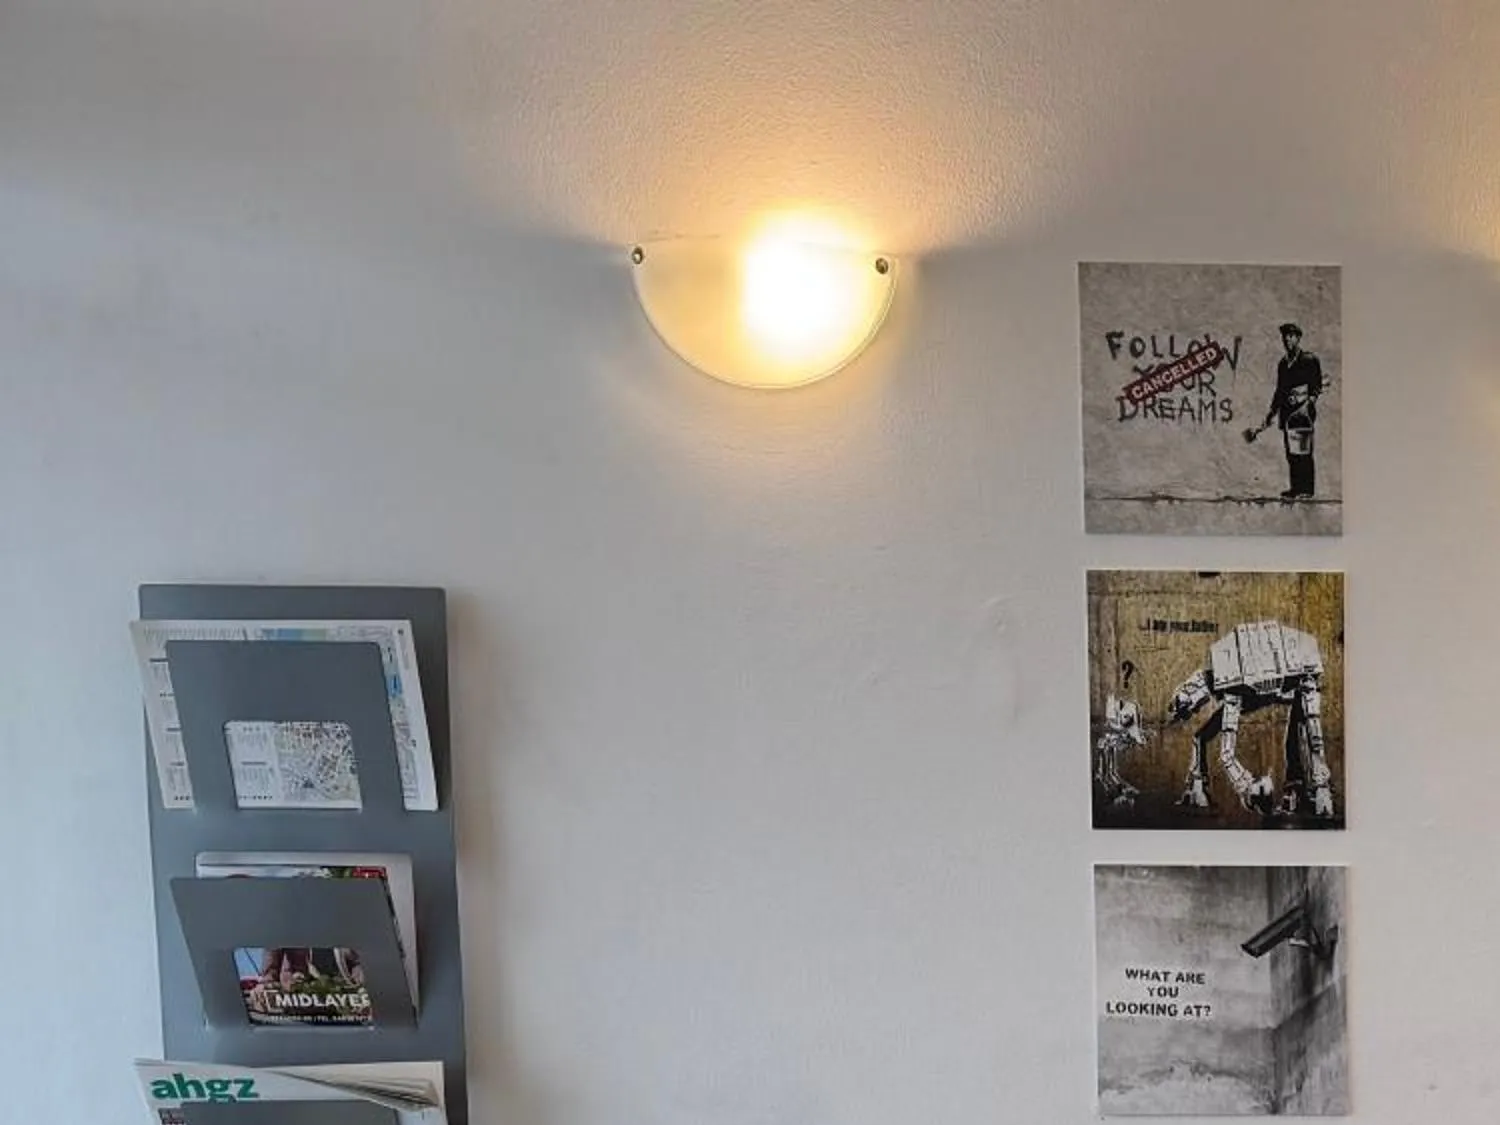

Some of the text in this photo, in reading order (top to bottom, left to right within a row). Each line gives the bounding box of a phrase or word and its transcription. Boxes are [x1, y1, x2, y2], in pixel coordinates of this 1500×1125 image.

[1131, 348, 1217, 400] CANCELLED
[1116, 395, 1233, 423] DREAMS
[1125, 968, 1206, 984] WHAT ARE
[1147, 986, 1179, 998] YOU
[1106, 1001, 1212, 1018] LOOKING AT?
[150, 1073, 260, 1102] ahgz
